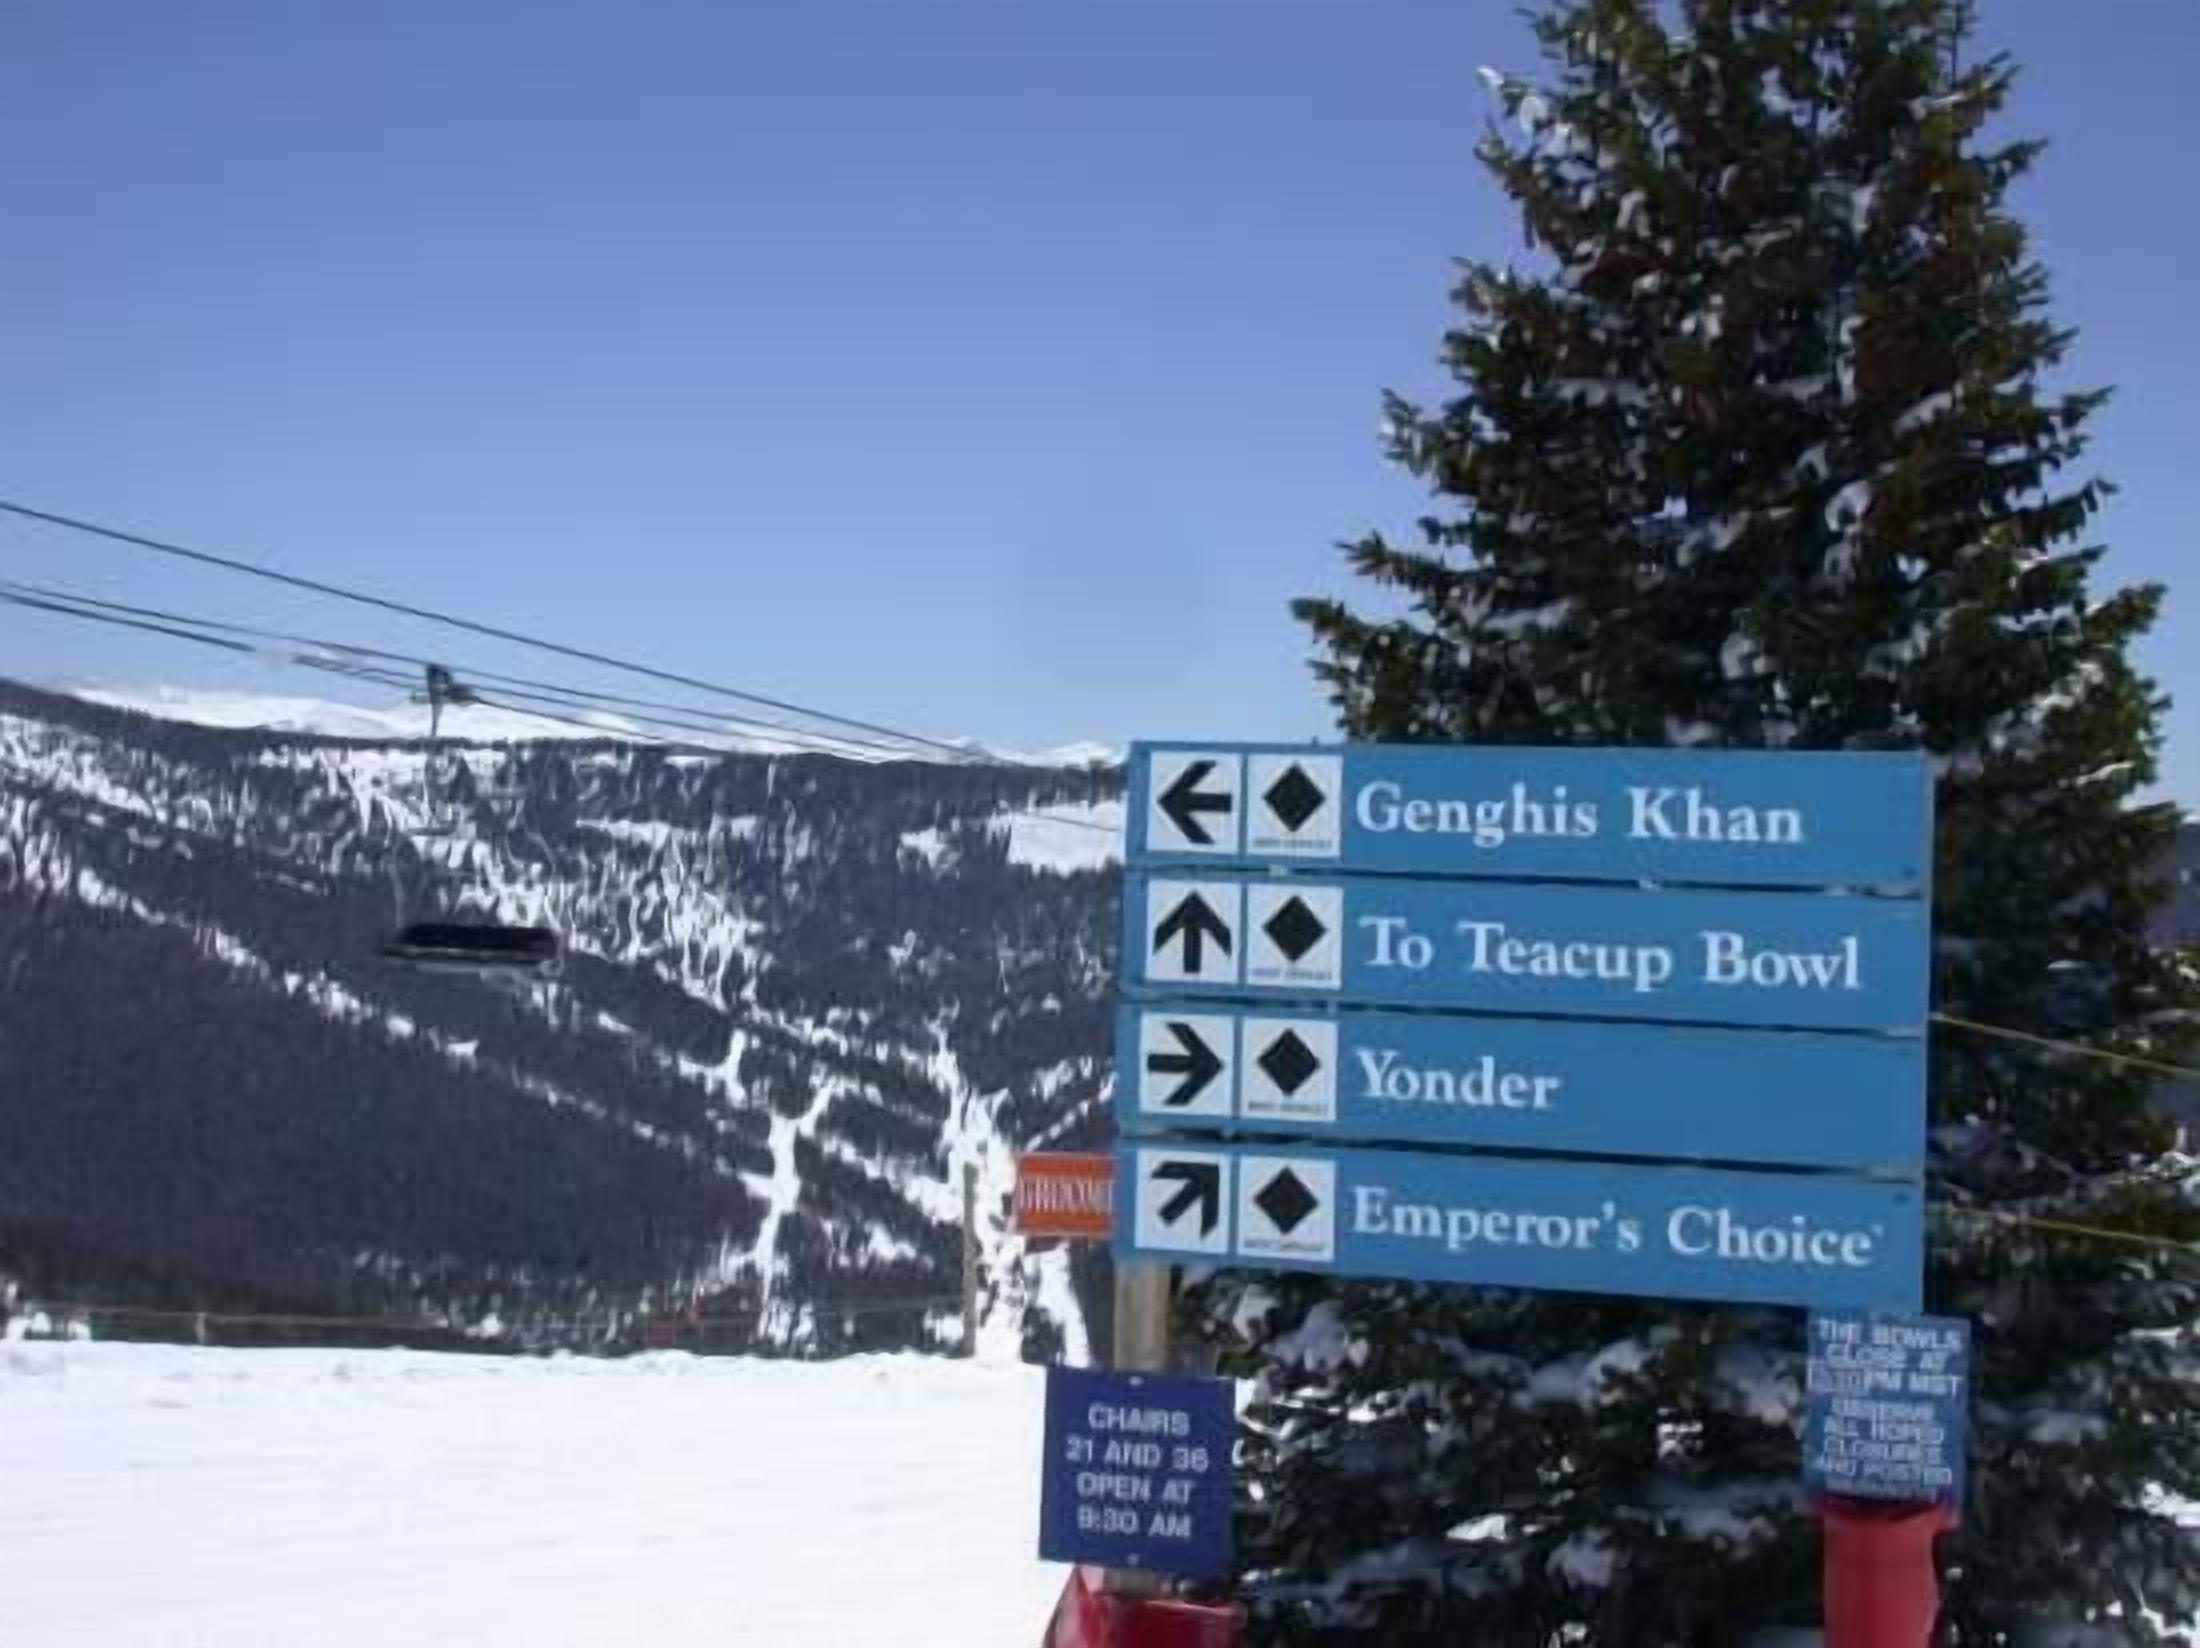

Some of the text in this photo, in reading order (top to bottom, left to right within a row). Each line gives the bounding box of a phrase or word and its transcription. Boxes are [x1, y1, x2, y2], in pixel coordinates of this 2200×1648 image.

[1356, 781, 1803, 847] Genghis Khan
[1359, 916, 1859, 992] To Teacup Bowl
[1356, 1048, 1560, 1108] Yonder
[1353, 1185, 1872, 1266] Emperor's Choice
[1088, 1402, 1190, 1436] CHAIRS
[1065, 1434, 1093, 1463] 21
[1104, 1440, 1161, 1468] AND
[1077, 1471, 1196, 1504] OPEN AT
[1148, 1511, 1192, 1538] AM
